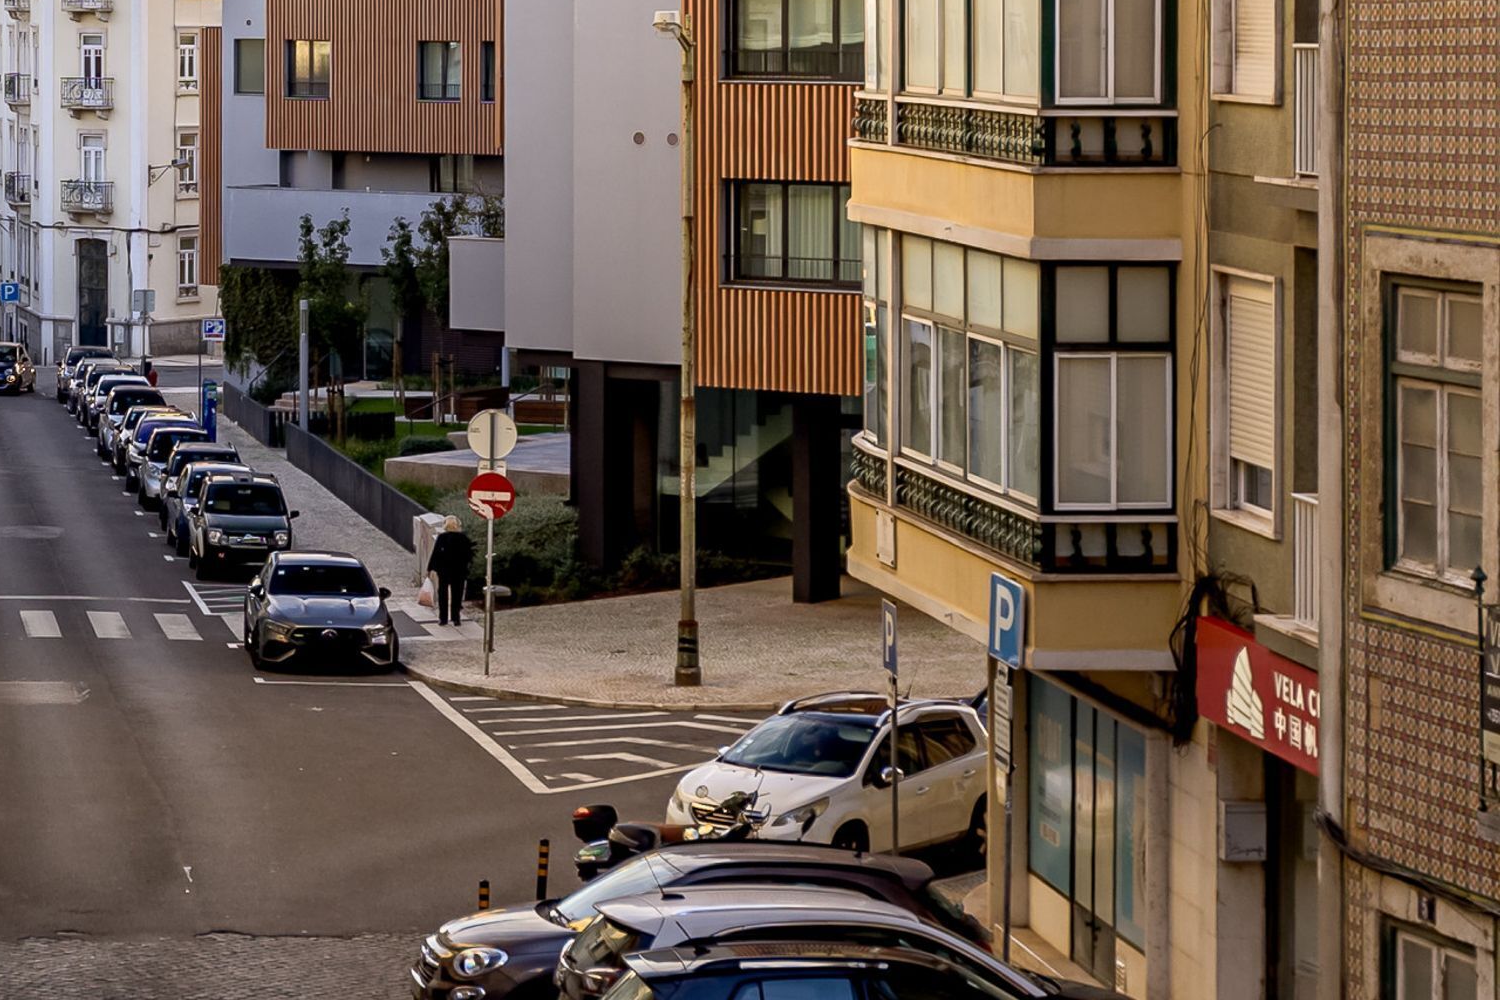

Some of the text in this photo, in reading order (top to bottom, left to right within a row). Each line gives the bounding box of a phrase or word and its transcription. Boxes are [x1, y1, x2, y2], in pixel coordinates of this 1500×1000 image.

[4, 285, 15, 299] P
[205, 321, 214, 332] P
[885, 610, 894, 662] P
[994, 583, 1014, 652] P
[1273, 671, 1305, 711] VELA
